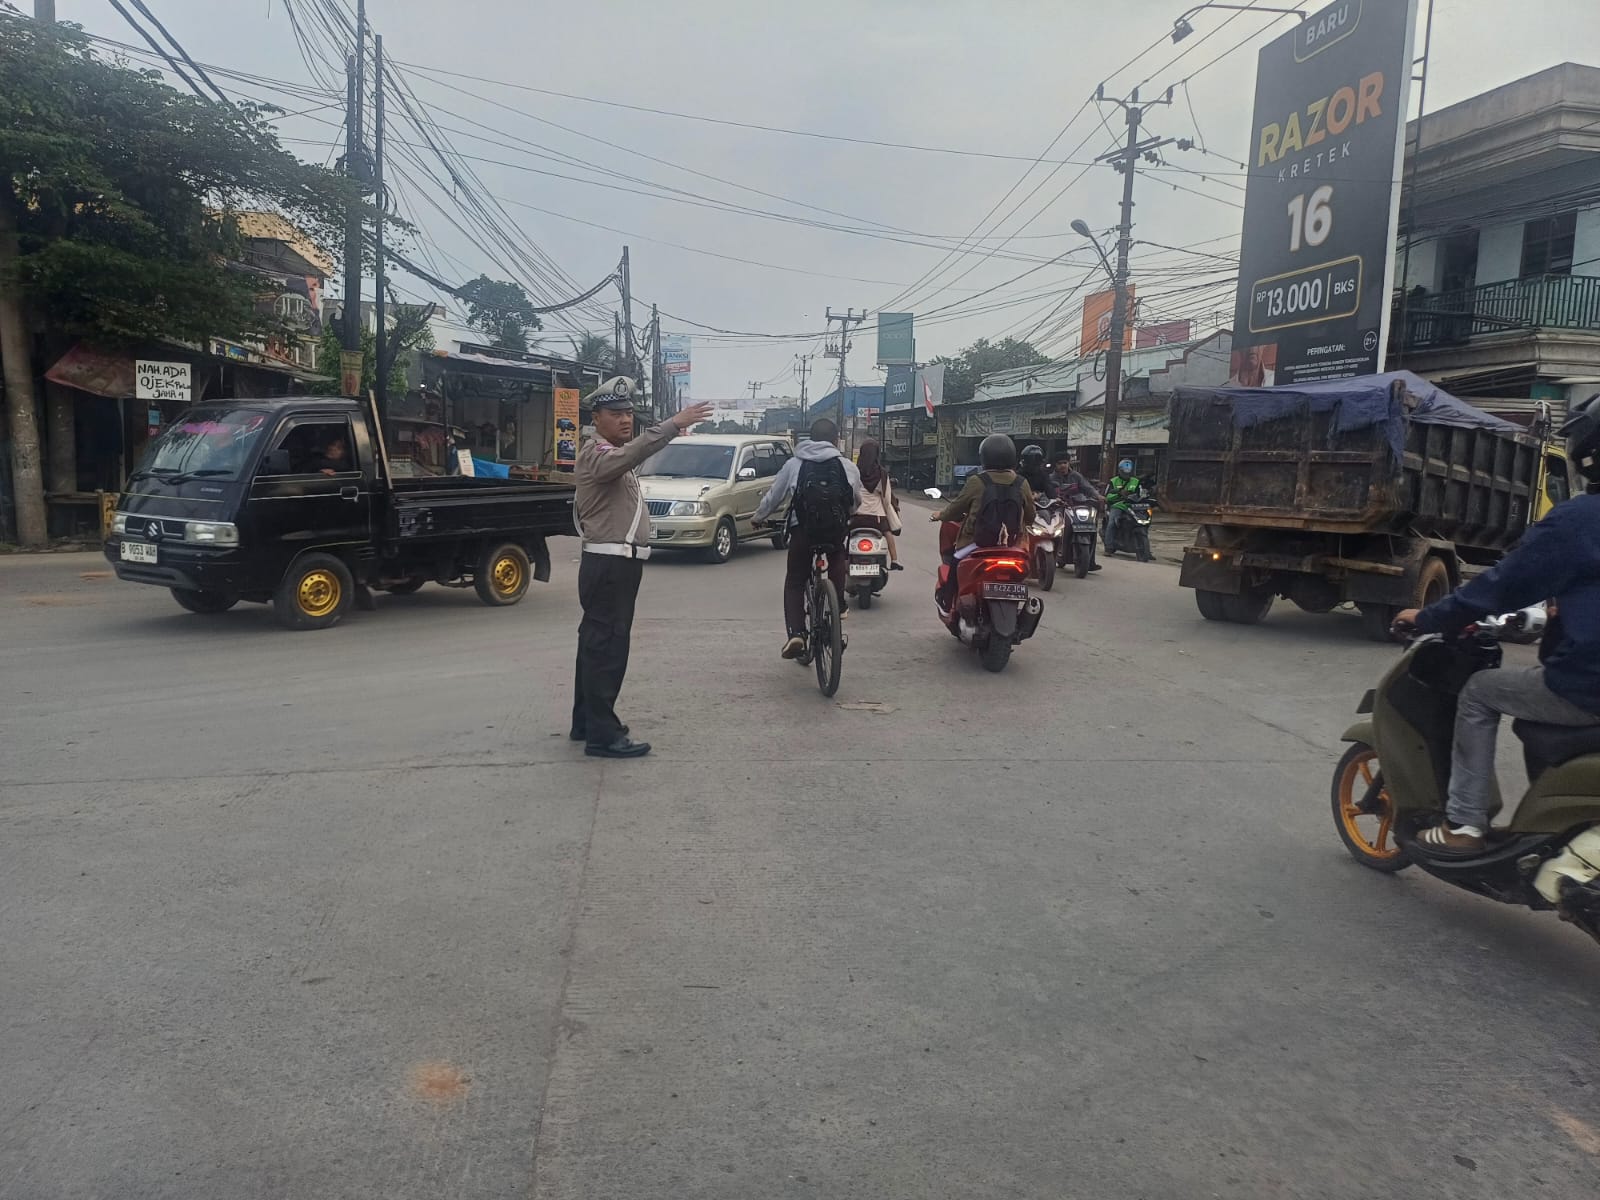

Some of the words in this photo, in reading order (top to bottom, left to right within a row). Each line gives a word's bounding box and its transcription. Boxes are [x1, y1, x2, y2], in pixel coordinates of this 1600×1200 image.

[1306, 4, 1350, 46] BARU
[1258, 71, 1384, 168] RAZOR
[1278, 142, 1352, 183] KRETEK
[1287, 185, 1334, 252] 16
[1267, 278, 1322, 317] 13.000
[1333, 279, 1355, 296] BKS
